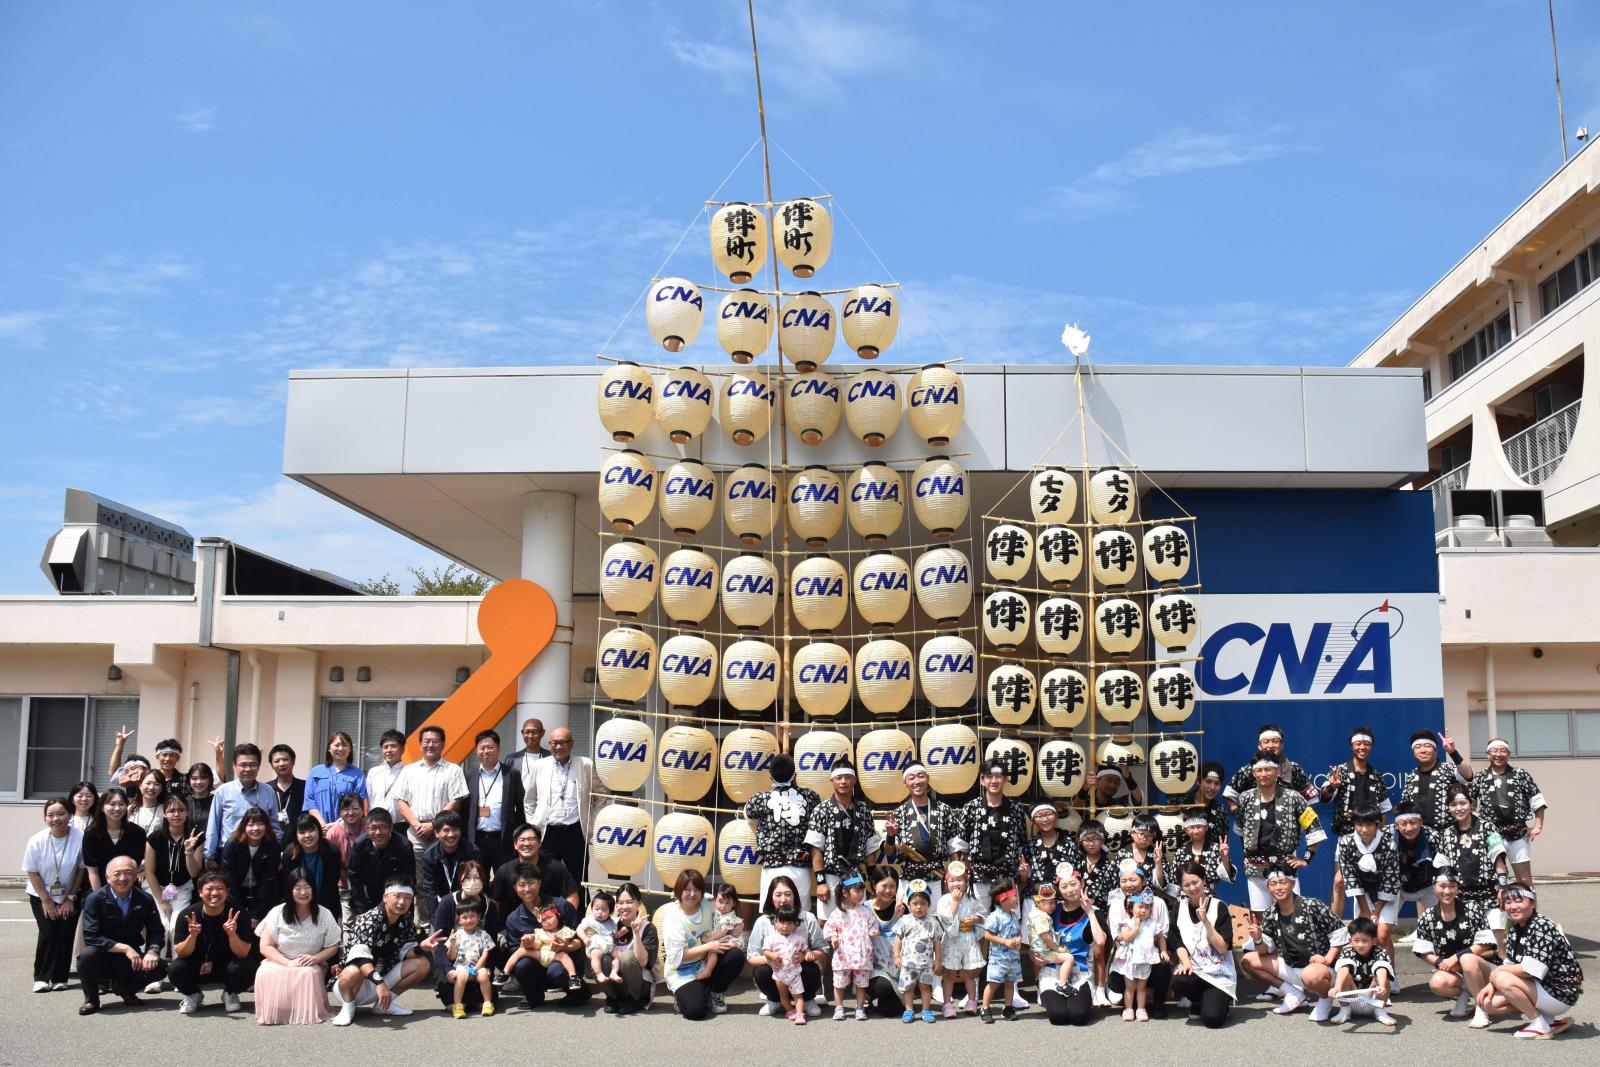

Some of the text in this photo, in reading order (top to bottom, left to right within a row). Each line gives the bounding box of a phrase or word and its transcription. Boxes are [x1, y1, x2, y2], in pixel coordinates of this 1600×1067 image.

[656, 286, 703, 312] CNA
[843, 297, 892, 318] CNA
[722, 302, 770, 324] CNA
[782, 309, 830, 330] CNA
[604, 379, 652, 404] CNA
[663, 379, 710, 405] CNA
[727, 381, 775, 407] CNA
[790, 379, 839, 404] CNA
[848, 379, 896, 403] CNA
[910, 385, 959, 407] CNA
[604, 466, 653, 492] CNA
[665, 477, 714, 500] CNA
[915, 475, 964, 498] CNA
[729, 480, 776, 503] CNA
[791, 483, 839, 504] CNA
[851, 480, 899, 502] CNA
[1040, 474, 1063, 513] 七夕
[1106, 474, 1129, 513] 七夕
[605, 559, 654, 582] CNA
[664, 567, 713, 590] CNA
[860, 571, 909, 592] CNA
[920, 563, 968, 587] CNA
[725, 574, 774, 596] CNA
[795, 576, 844, 597] CNA
[600, 647, 650, 670] CNA
[662, 653, 711, 677] CNA
[924, 653, 974, 674] CNA
[1195, 622, 1394, 695] CNA
[726, 660, 776, 681] CNA
[799, 664, 848, 684] CNA
[861, 660, 911, 681] CNA
[598, 739, 648, 762] CNA
[661, 749, 712, 771] CNA
[863, 751, 912, 772] CNA
[926, 745, 976, 766] CNA
[596, 825, 646, 848] CNA
[656, 835, 707, 857] CNA
[724, 844, 762, 865] CN
